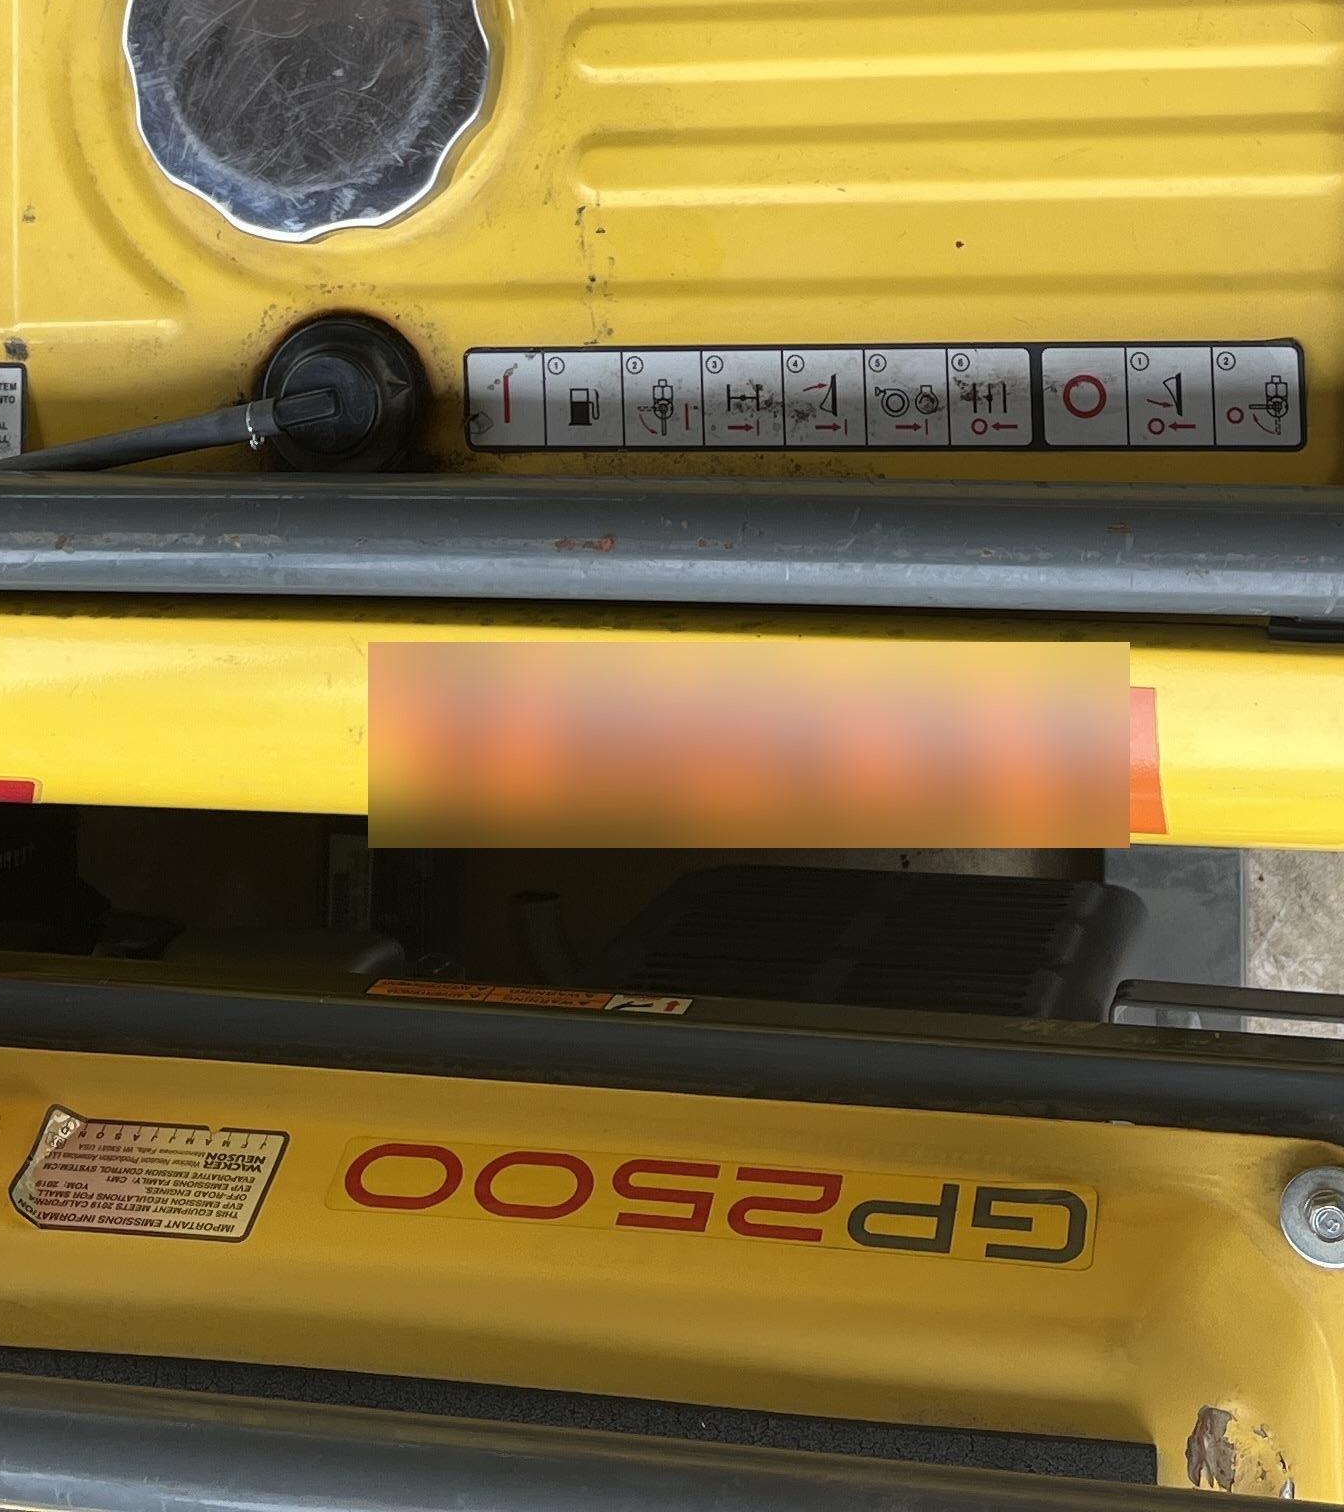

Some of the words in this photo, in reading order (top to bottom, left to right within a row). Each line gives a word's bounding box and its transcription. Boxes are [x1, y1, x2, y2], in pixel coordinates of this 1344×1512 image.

[206, 1152, 267, 1164] NEUSON
[203, 1160, 262, 1173] WACKER
[344, 1143, 1088, 1264] GP2500
